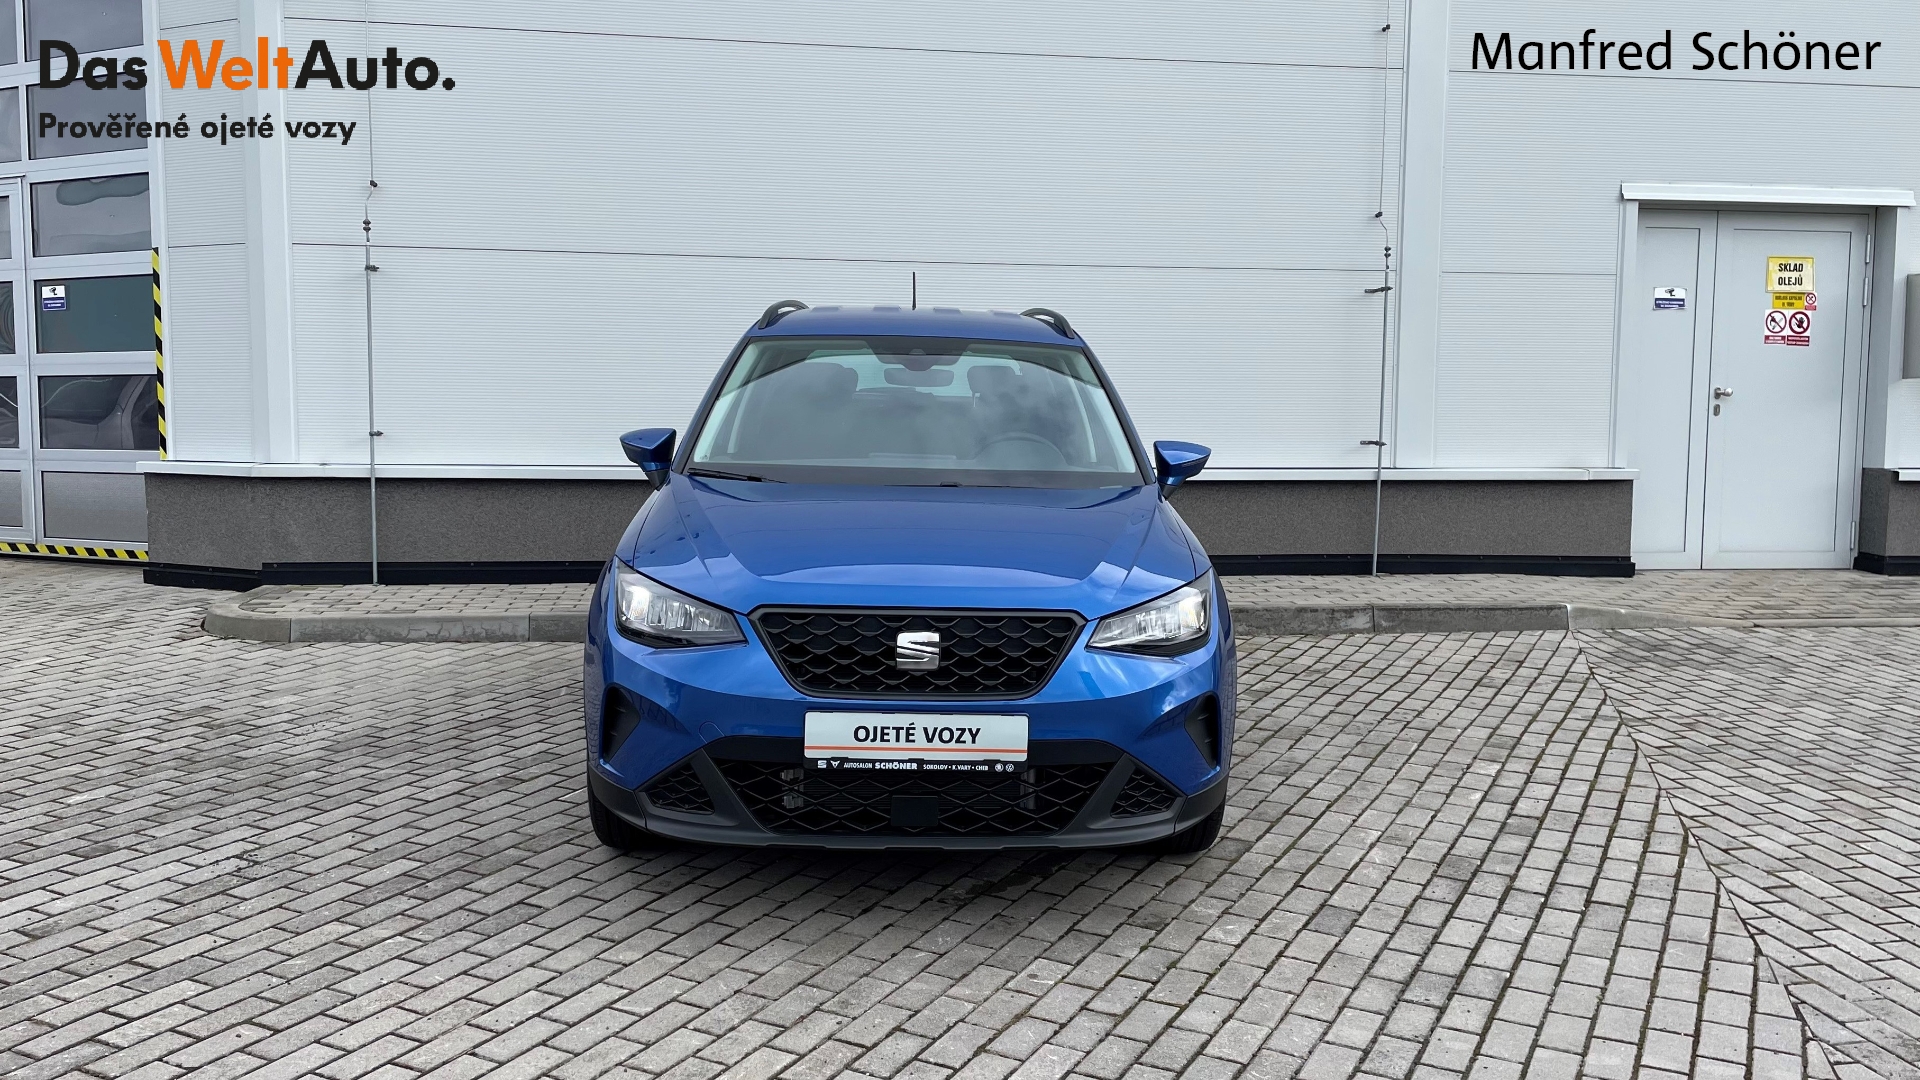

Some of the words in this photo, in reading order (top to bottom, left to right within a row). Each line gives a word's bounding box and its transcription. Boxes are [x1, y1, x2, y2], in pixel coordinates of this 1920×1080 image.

[1778, 263, 1804, 272] SKLAD
[1777, 274, 1803, 286] OLEJŮ
[853, 722, 916, 743] OJETÉ
[922, 726, 981, 744] VOZY
[874, 762, 918, 770] SCHÖNER
